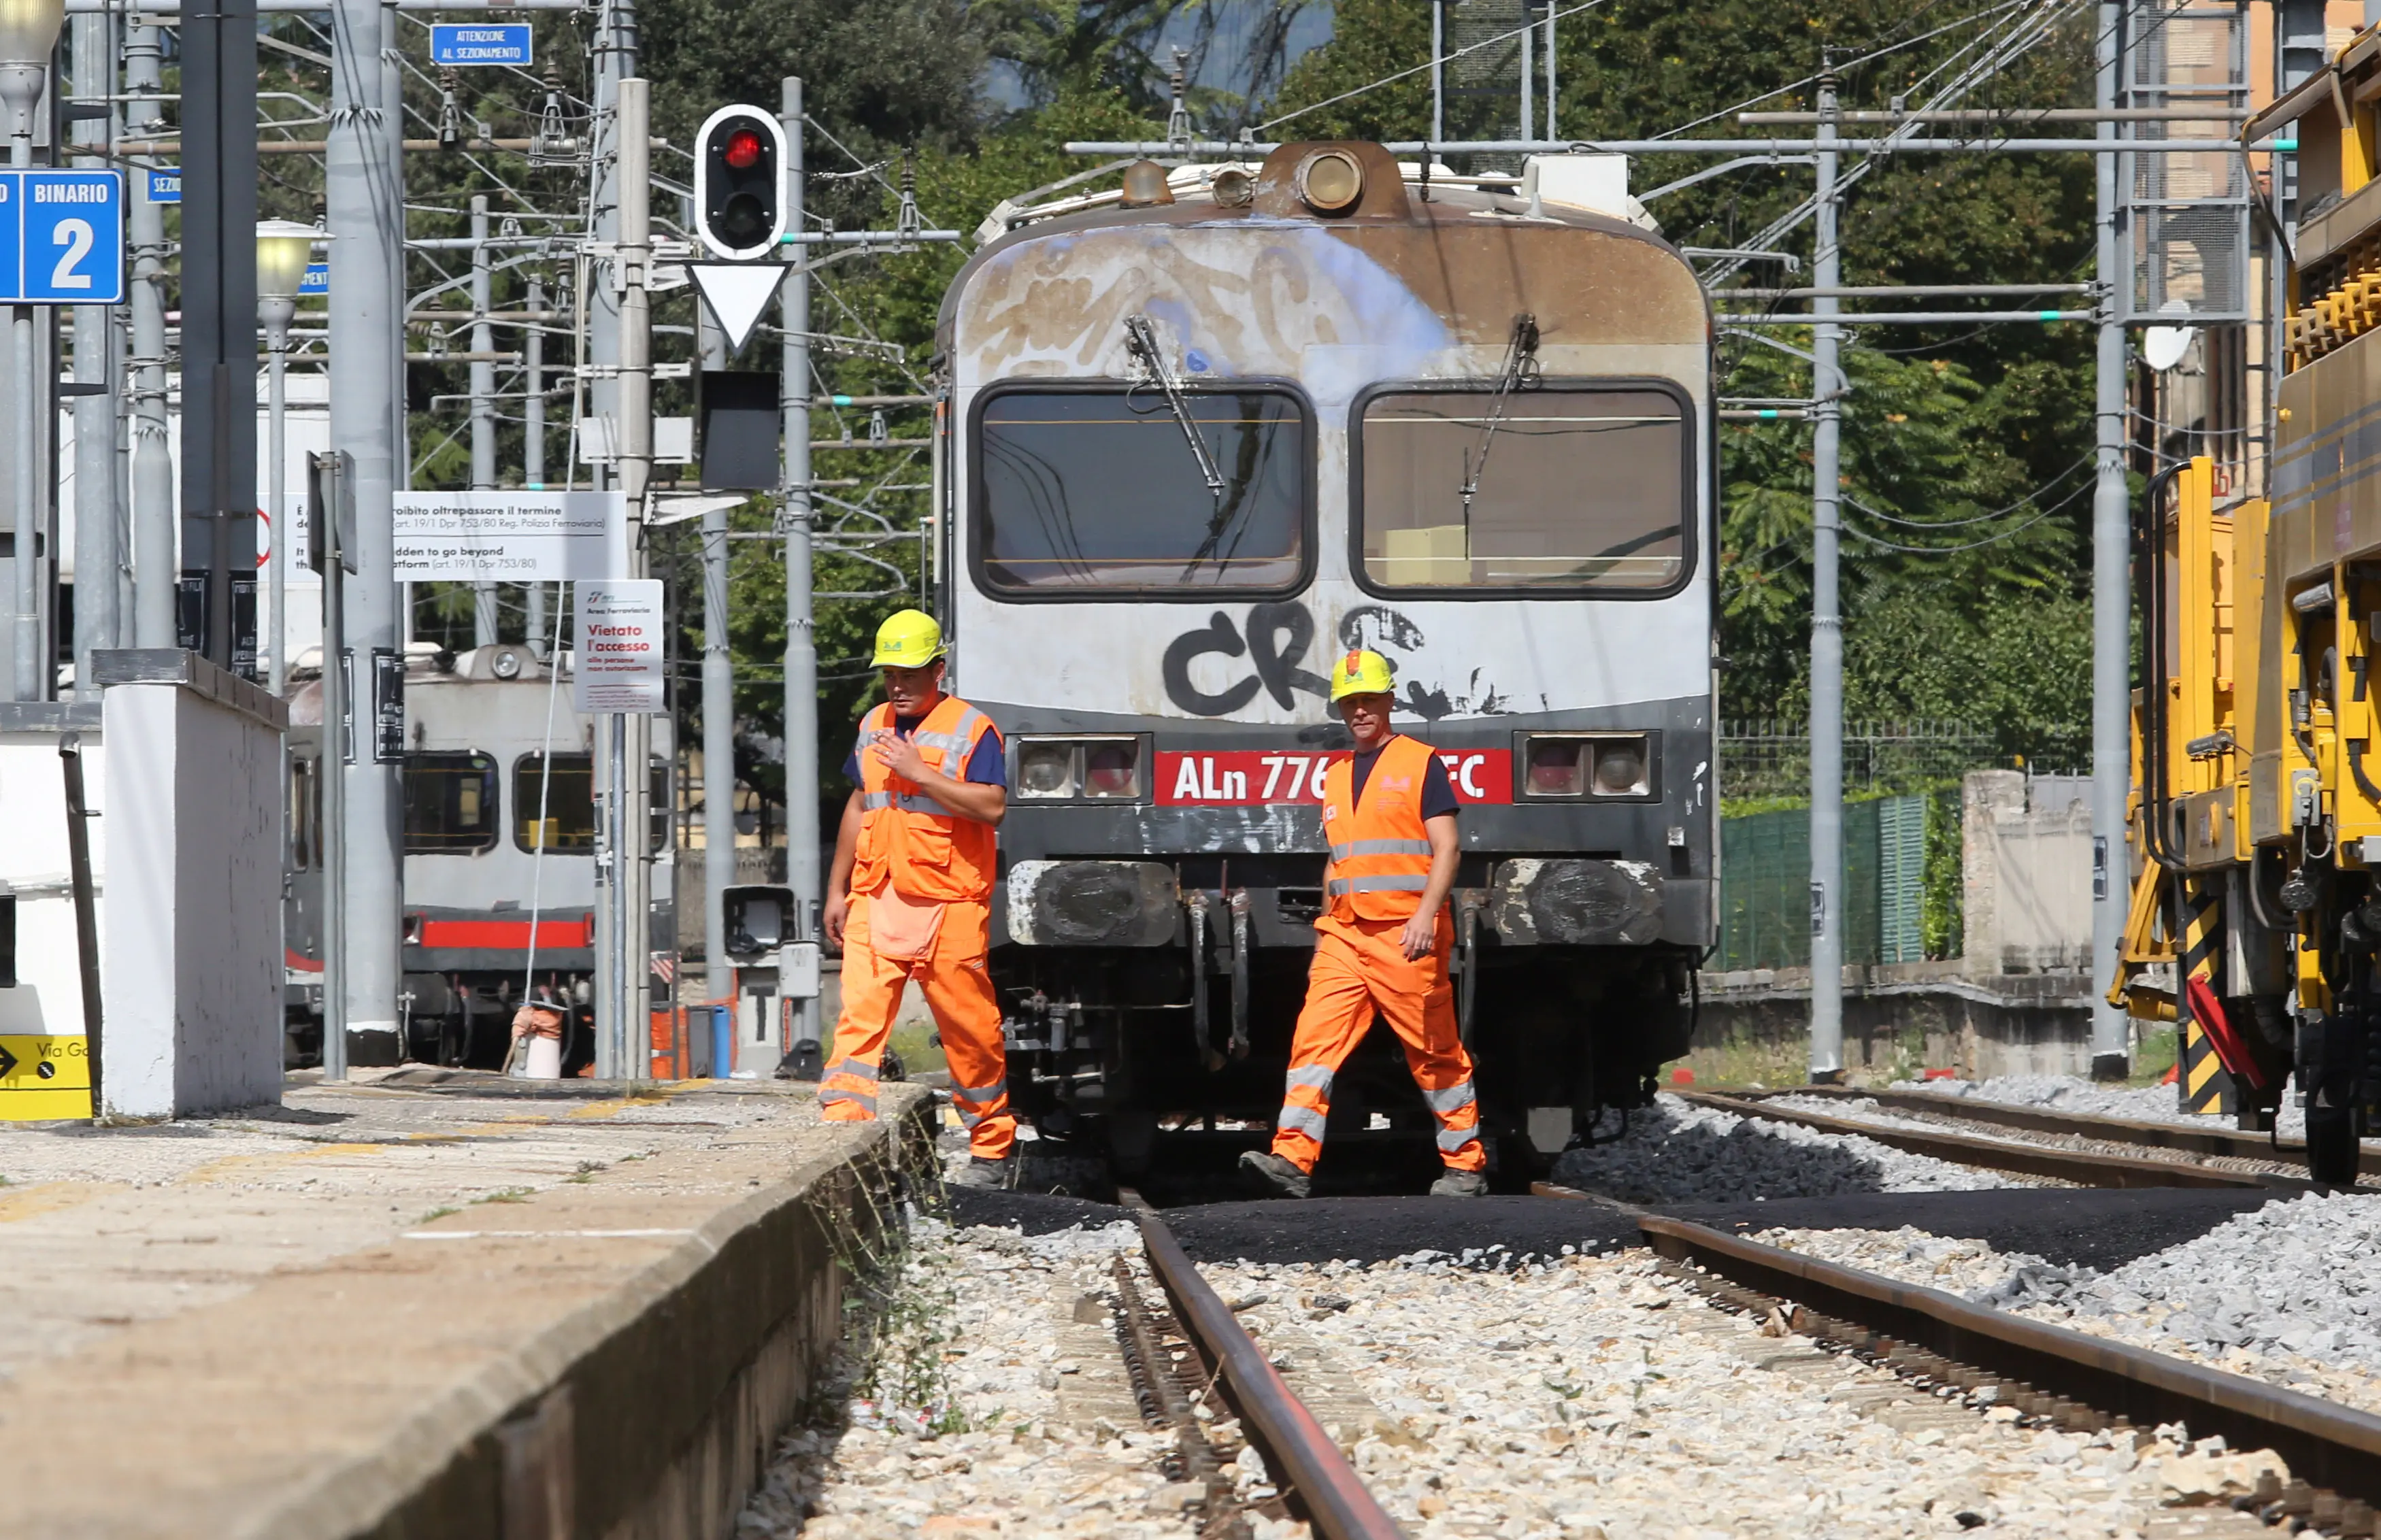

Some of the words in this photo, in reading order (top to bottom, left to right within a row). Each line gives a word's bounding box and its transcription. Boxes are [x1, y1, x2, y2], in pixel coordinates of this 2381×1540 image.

[456, 31, 506, 41] ATTENZIONE
[442, 48, 453, 58] AL
[456, 47, 521, 59] SEZIONAMENTO
[35, 184, 108, 203] BINARIO
[50, 218, 94, 288] 2
[432, 506, 504, 518] oltrepassare
[507, 506, 514, 516] il
[518, 506, 562, 516] termine
[414, 518, 436, 529] 19/1
[439, 519, 456, 530] Dpr
[460, 518, 497, 529] 753/80
[499, 519, 519, 529] Reg.
[521, 518, 550, 528] Polizia
[552, 518, 605, 529] Ferroviaria)
[395, 547, 424, 556] dden
[428, 548, 439, 556] to
[443, 549, 457, 558] go
[461, 546, 504, 558] beyond
[454, 559, 476, 569] 19/1
[479, 560, 496, 570] Dpr
[498, 558, 537, 570] 753/80)
[587, 624, 643, 636] Vietato
[587, 639, 650, 652] l'accesso
[1172, 756, 1247, 799] ALn
[36, 1042, 62, 1058] Via
